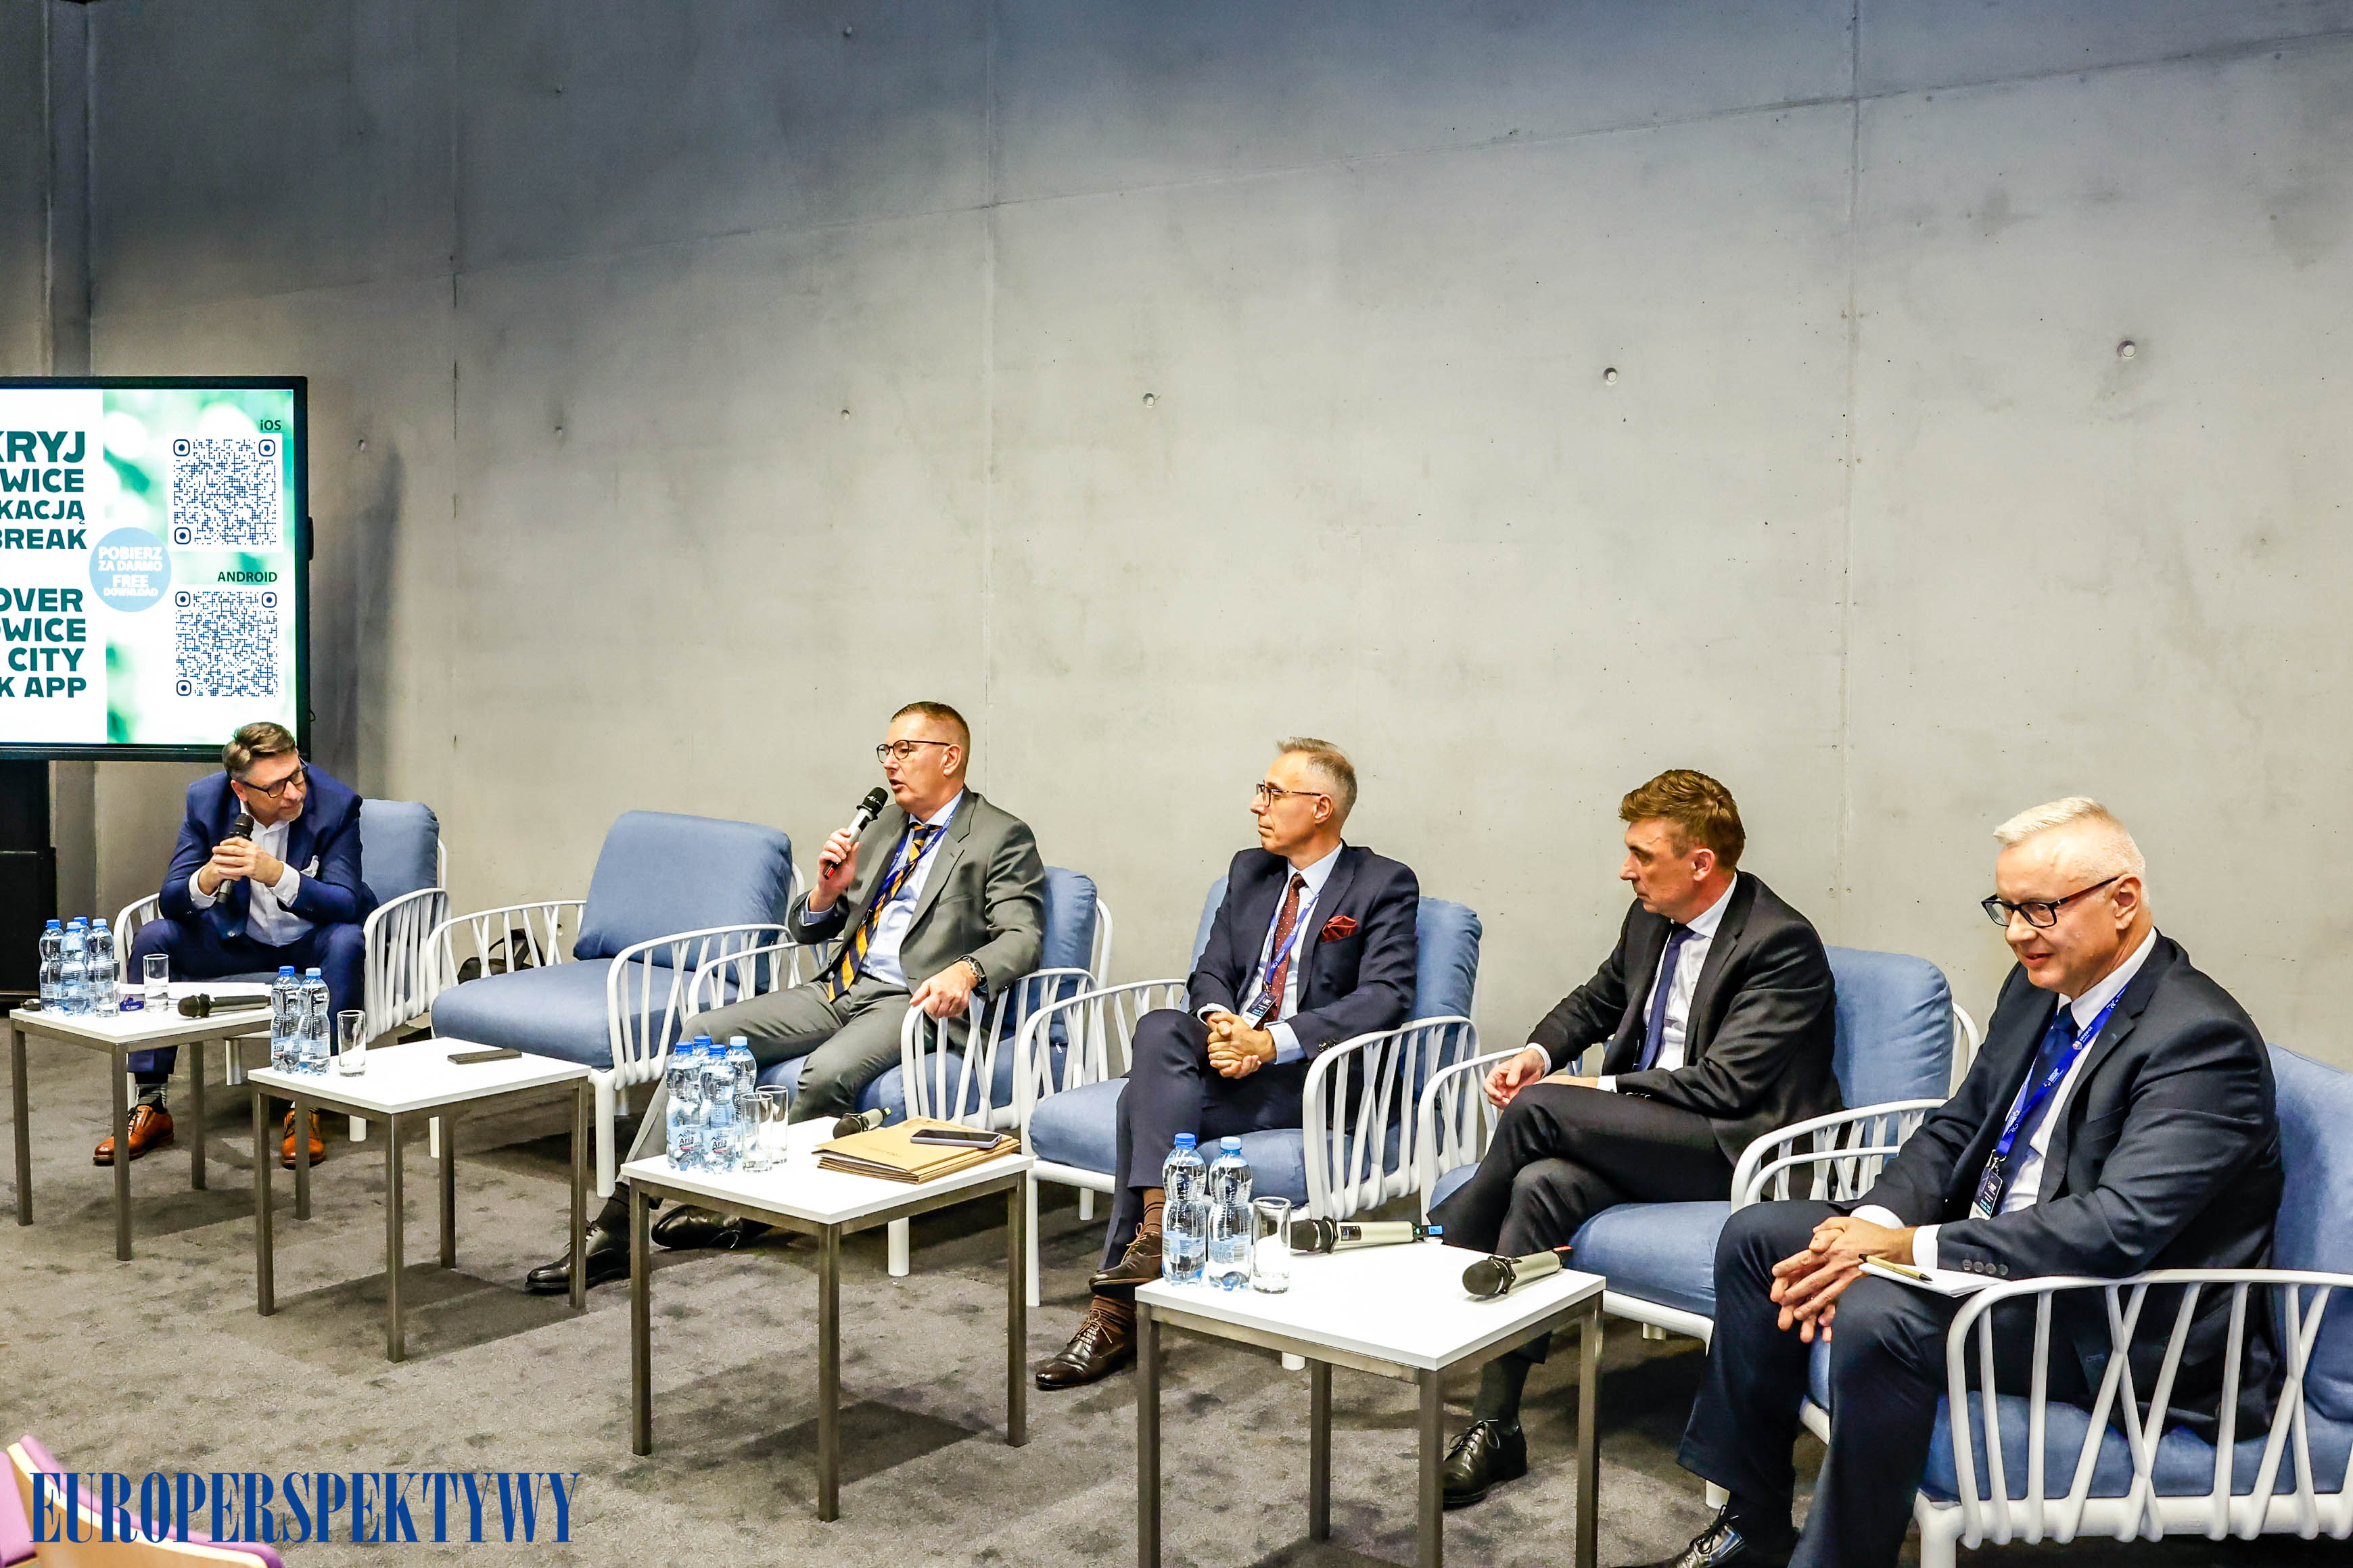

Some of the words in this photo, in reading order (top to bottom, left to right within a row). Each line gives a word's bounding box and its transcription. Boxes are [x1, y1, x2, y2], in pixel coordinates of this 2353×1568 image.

[260, 419, 281, 431] iOS
[0, 431, 85, 463] RYJ
[0, 528, 87, 549] REAK
[98, 546, 163, 560] POBIERZ
[97, 560, 116, 571] ZA
[112, 574, 149, 588] FREE
[217, 571, 278, 582] ANDROID
[8, 647, 85, 671] CITY
[24, 677, 87, 698] APP
[679, 1136, 694, 1145] Aria
[712, 1139, 727, 1148] Aria
